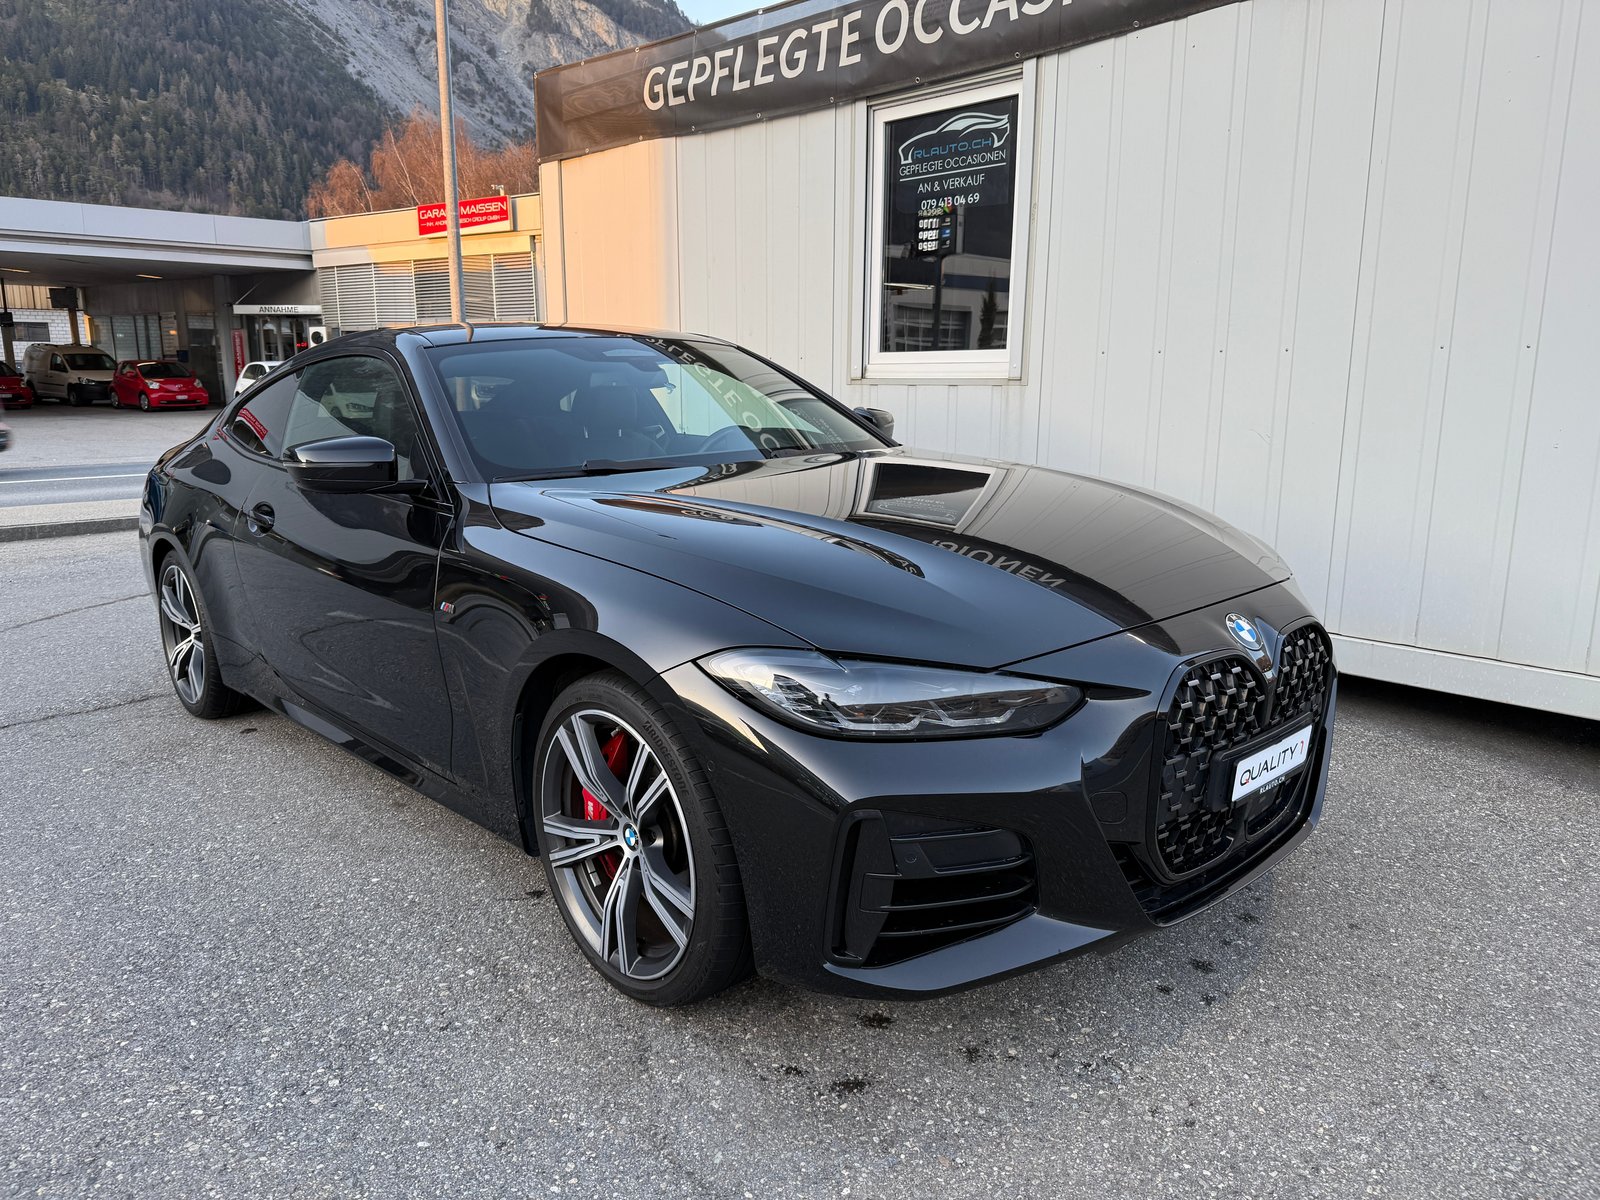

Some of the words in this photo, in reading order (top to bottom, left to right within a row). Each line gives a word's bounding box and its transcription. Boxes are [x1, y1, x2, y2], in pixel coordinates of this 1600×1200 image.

[643, 10, 863, 111] GEPFLEGTE
[913, 138, 992, 159] RLAUTO.CH
[899, 160, 943, 176] GEPFLEGTE
[944, 150, 1007, 169] OCCASIONEN
[917, 183, 932, 194] AN
[933, 181, 941, 191] &
[942, 174, 985, 190] VERKAUF
[419, 208, 447, 220] GARA
[460, 201, 507, 215] MAISSEN
[921, 200, 937, 210] 079
[938, 196, 953, 207] 413
[954, 195, 966, 205] 04
[967, 193, 980, 204] 69
[1240, 743, 1298, 786] QUALITY
